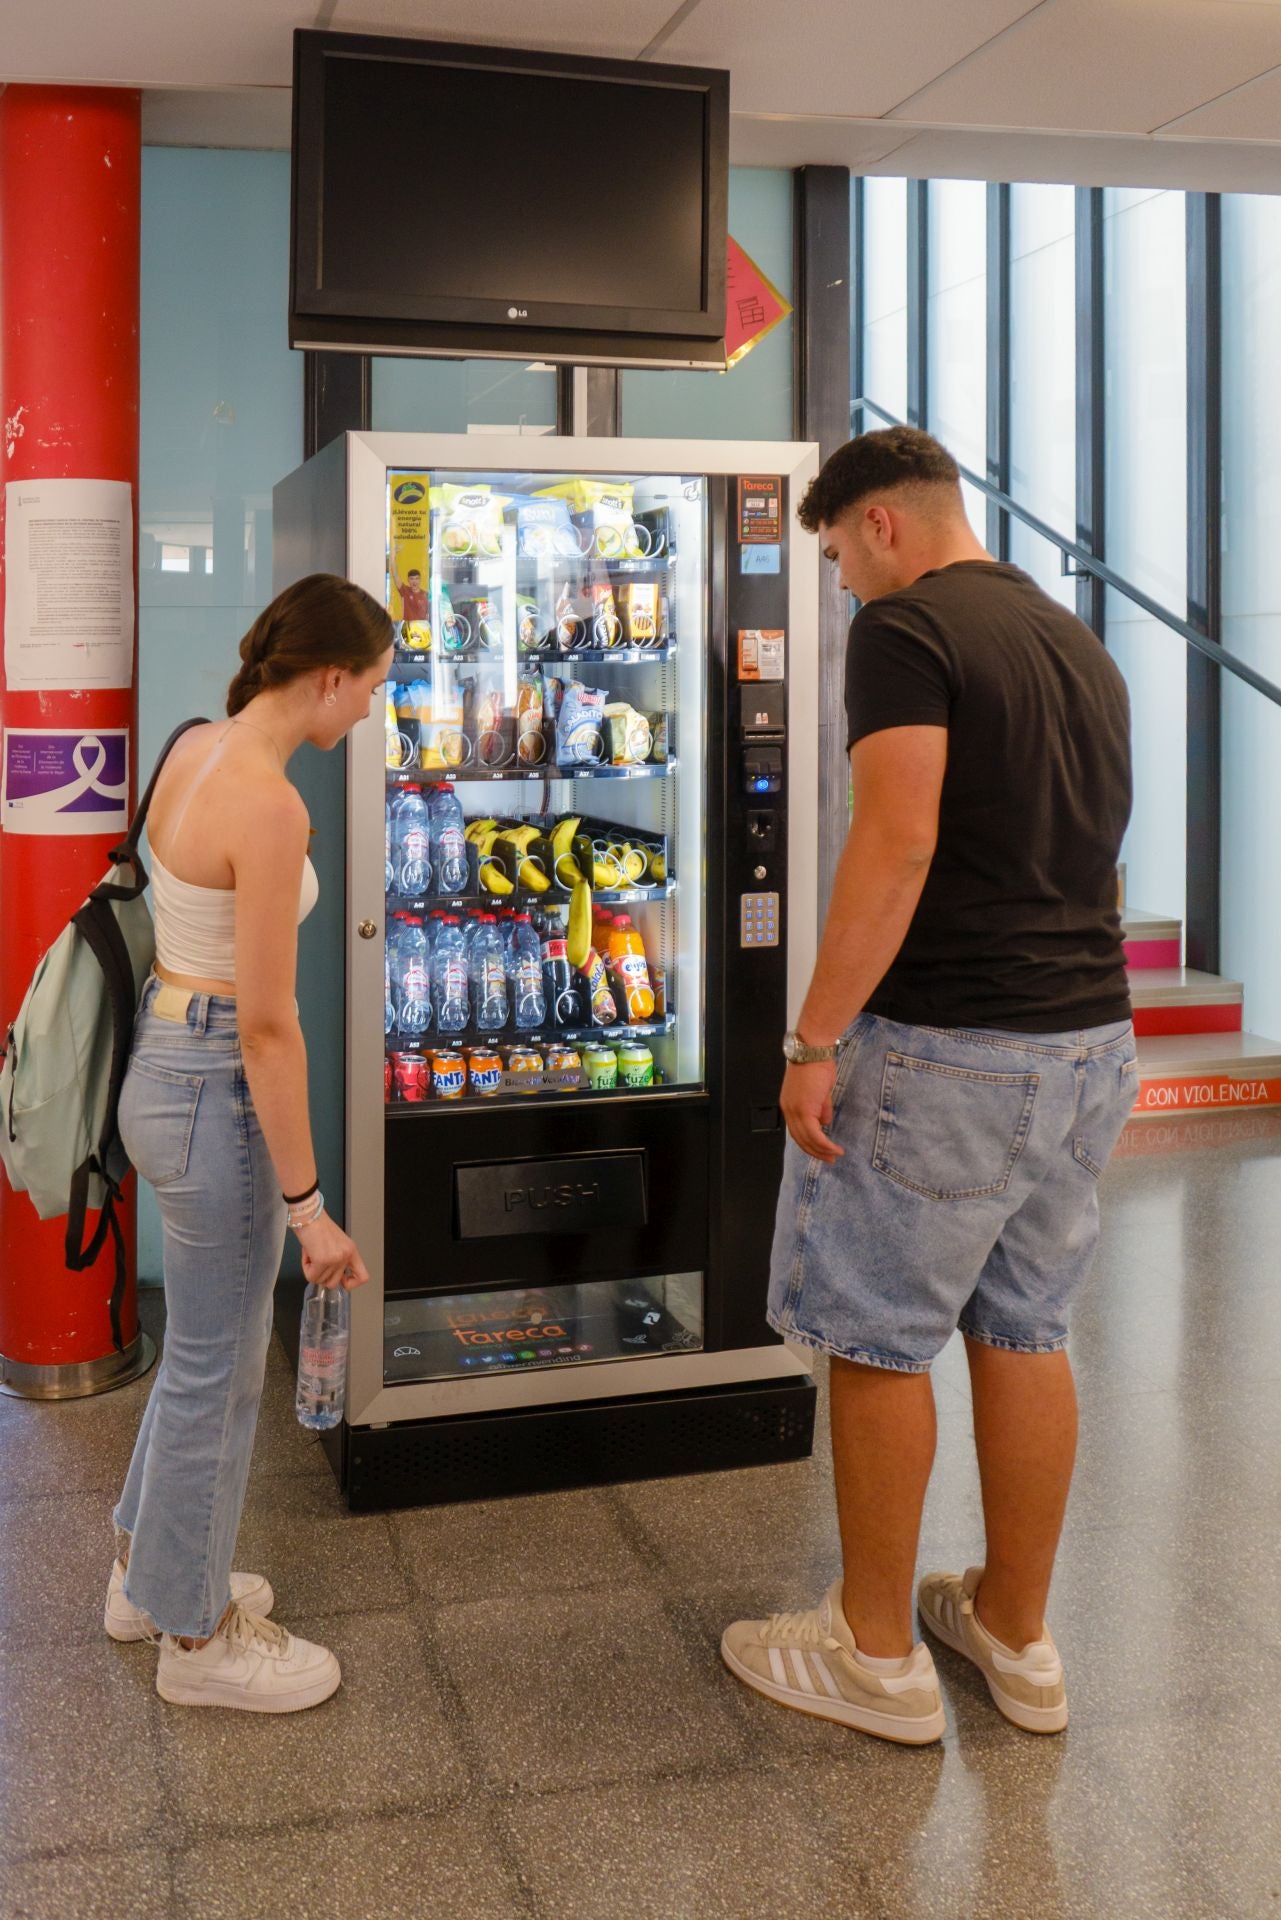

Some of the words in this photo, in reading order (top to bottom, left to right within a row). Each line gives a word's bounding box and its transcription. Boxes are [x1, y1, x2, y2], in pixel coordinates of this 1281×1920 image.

[518, 309, 528, 317] LG
[1146, 1087, 1178, 1106] CON
[1184, 1082, 1268, 1103] VIOLENCIA
[504, 1182, 599, 1212] PUSH
[453, 1325, 567, 1345] tareca
